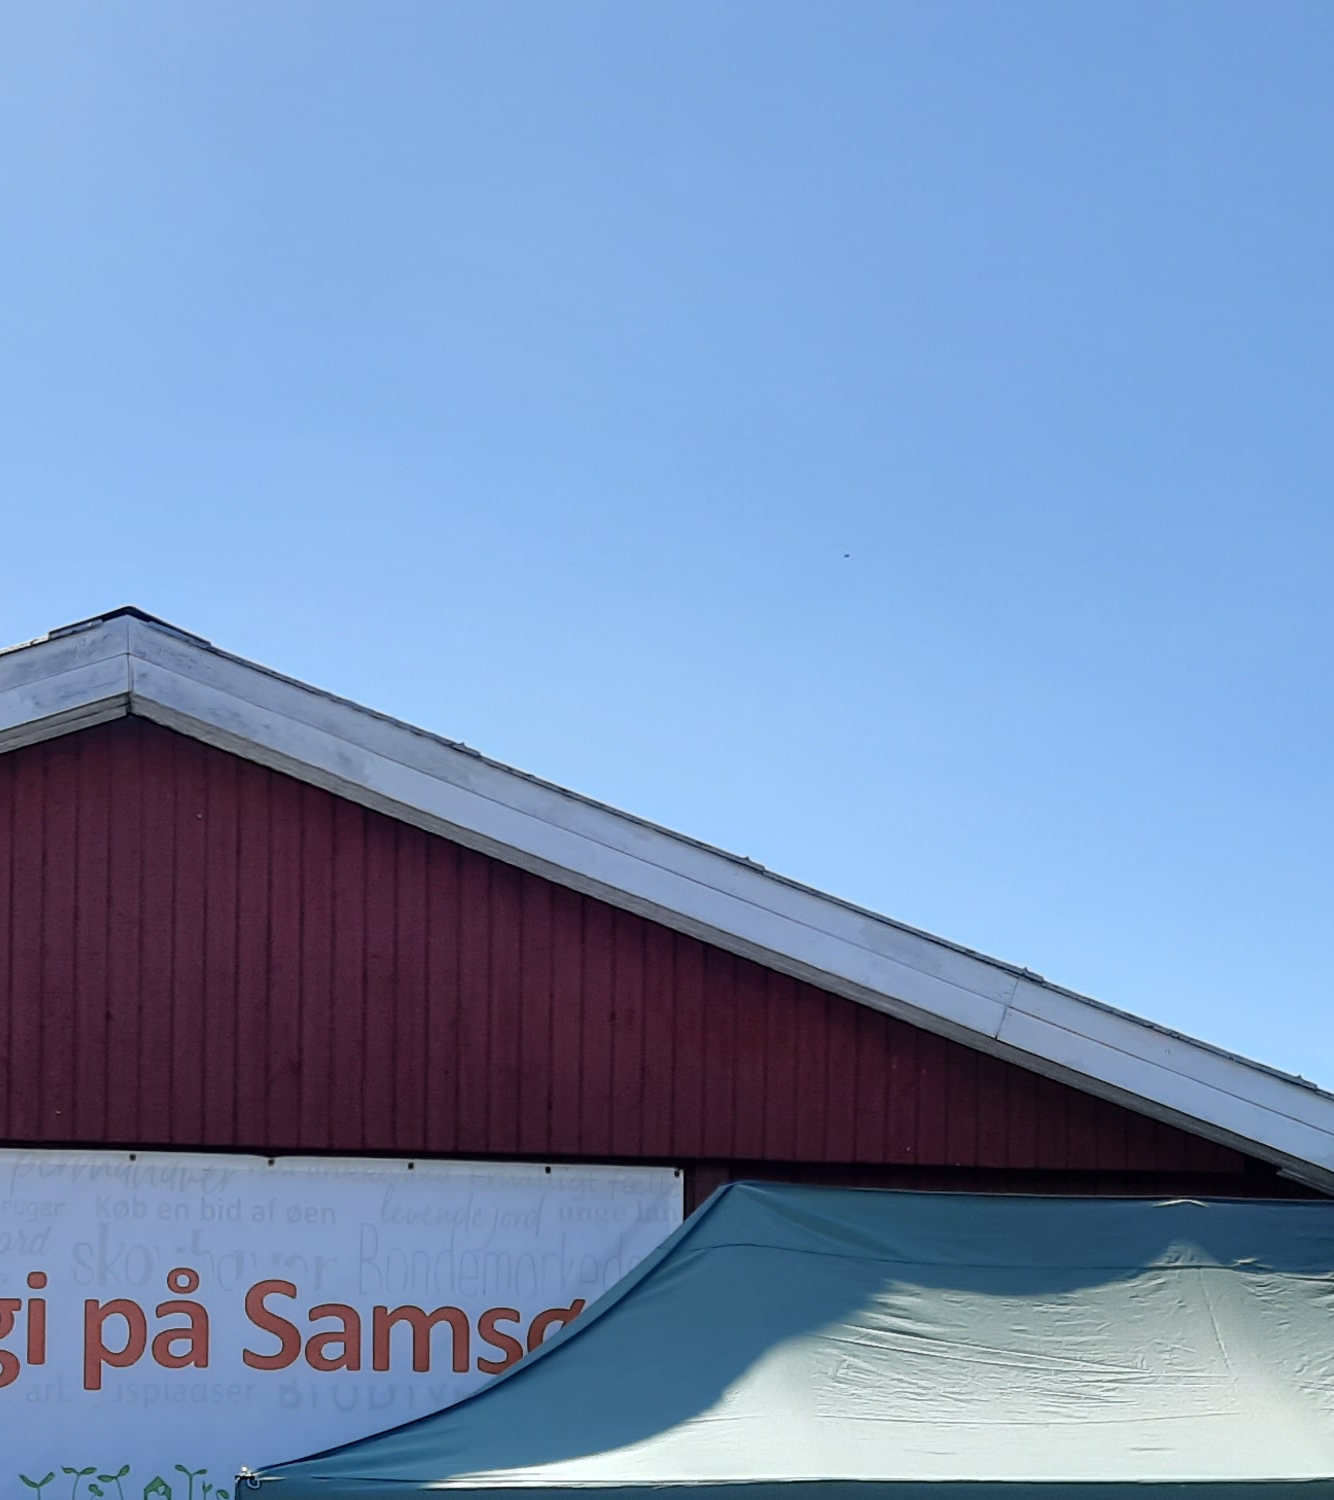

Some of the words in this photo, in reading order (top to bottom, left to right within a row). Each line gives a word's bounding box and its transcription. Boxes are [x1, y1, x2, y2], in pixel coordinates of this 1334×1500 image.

[157, 1200, 189, 1220] en
[200, 1197, 241, 1222] bid
[252, 1198, 277, 1223] af
[286, 1203, 336, 1225] øen
[83, 1268, 210, 1391] på
